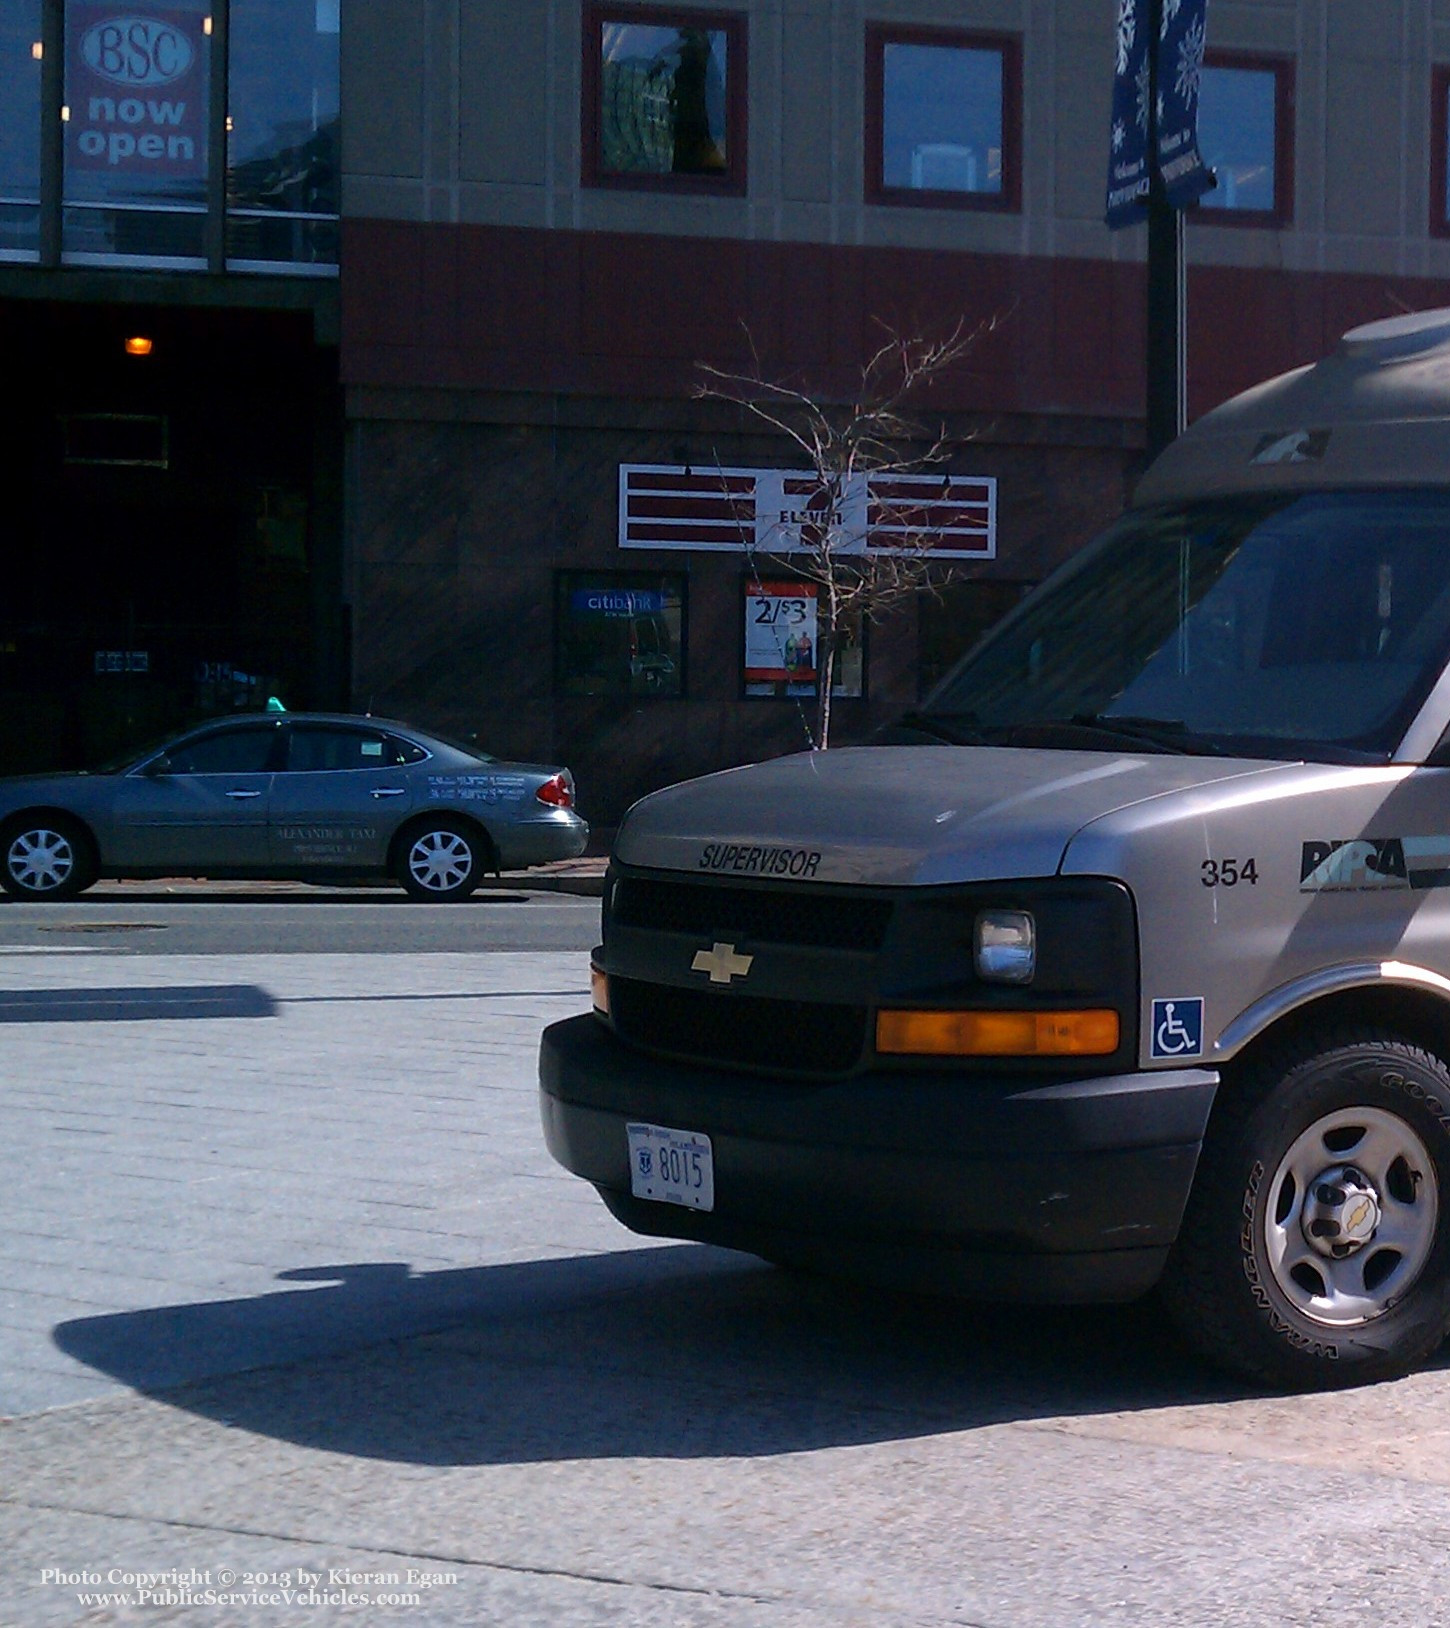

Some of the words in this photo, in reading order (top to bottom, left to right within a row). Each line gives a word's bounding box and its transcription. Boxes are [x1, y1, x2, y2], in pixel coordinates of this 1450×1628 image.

[99, 23, 178, 79] BSC
[88, 97, 187, 125] now
[78, 130, 195, 165] open
[588, 594, 651, 610] citibank
[699, 844, 822, 877] SUPERVISOR
[1201, 858, 1259, 888] 354
[659, 1146, 703, 1189] 8015
